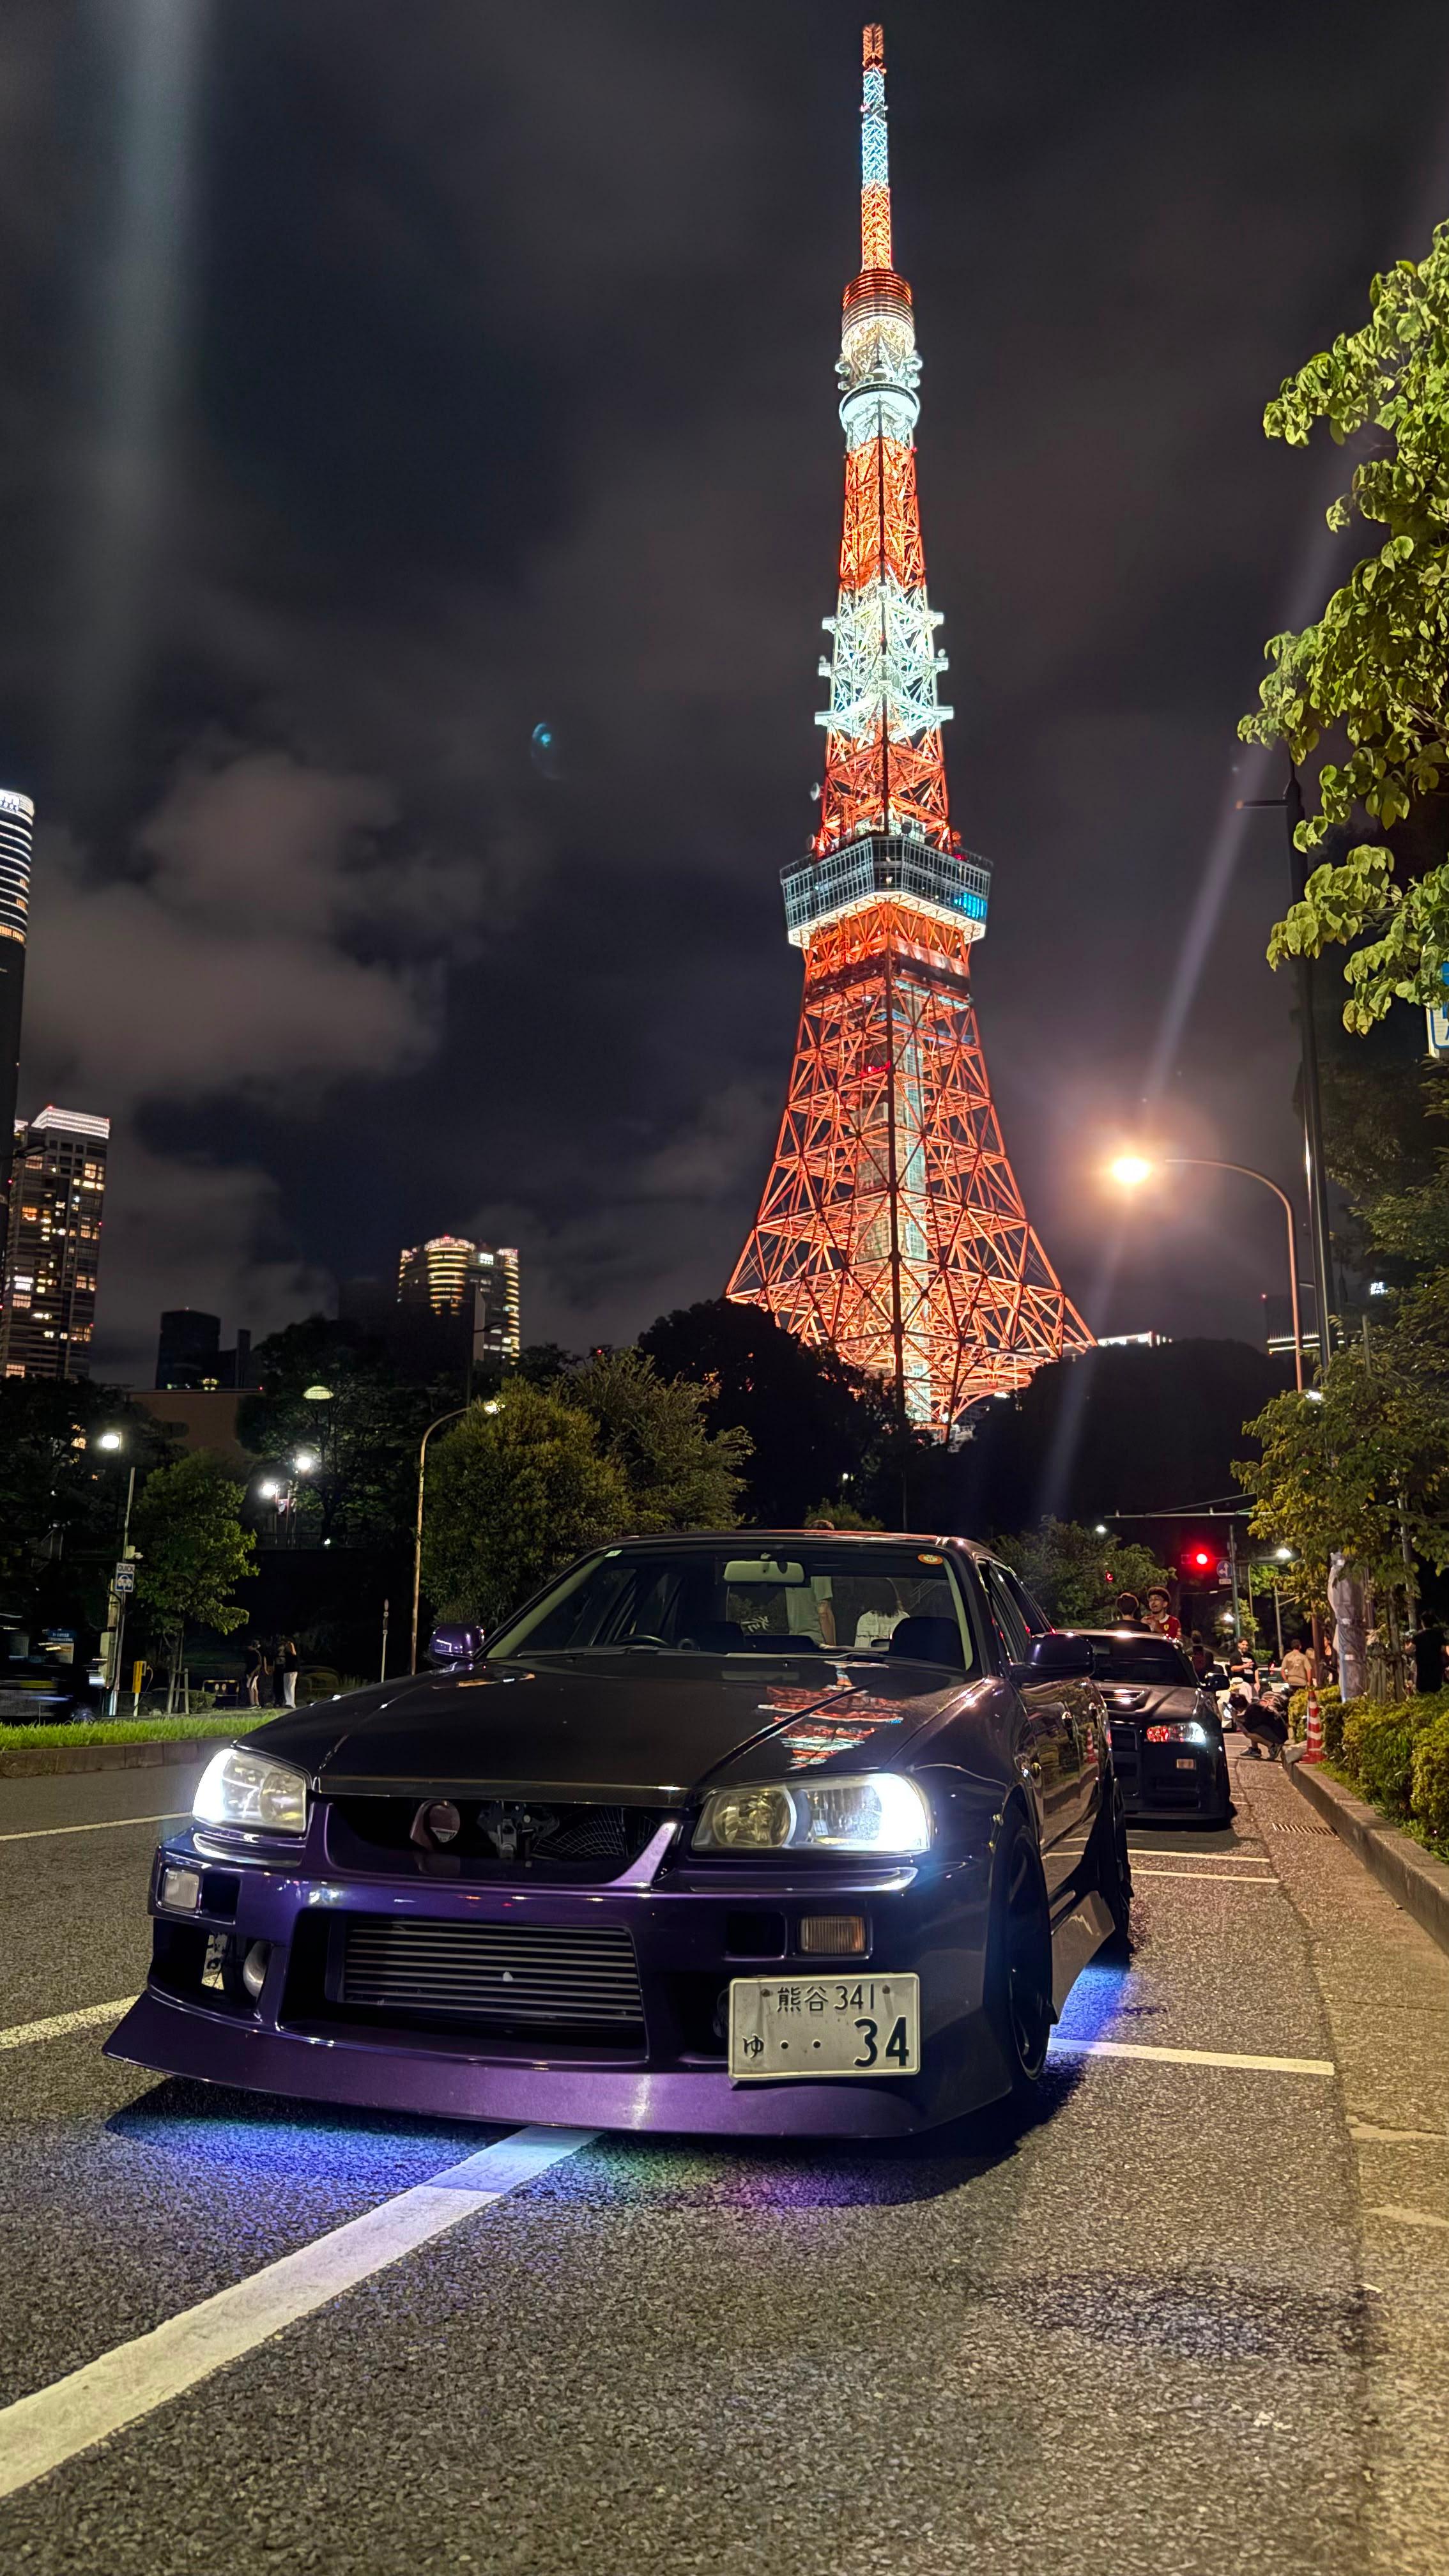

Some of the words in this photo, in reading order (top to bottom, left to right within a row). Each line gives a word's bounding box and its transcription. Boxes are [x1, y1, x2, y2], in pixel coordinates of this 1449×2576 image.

[776, 1986, 829, 2012] 熊谷
[833, 1984, 875, 2011] 341
[742, 2034, 764, 2059] ゆ
[853, 2015, 910, 2068] 34
